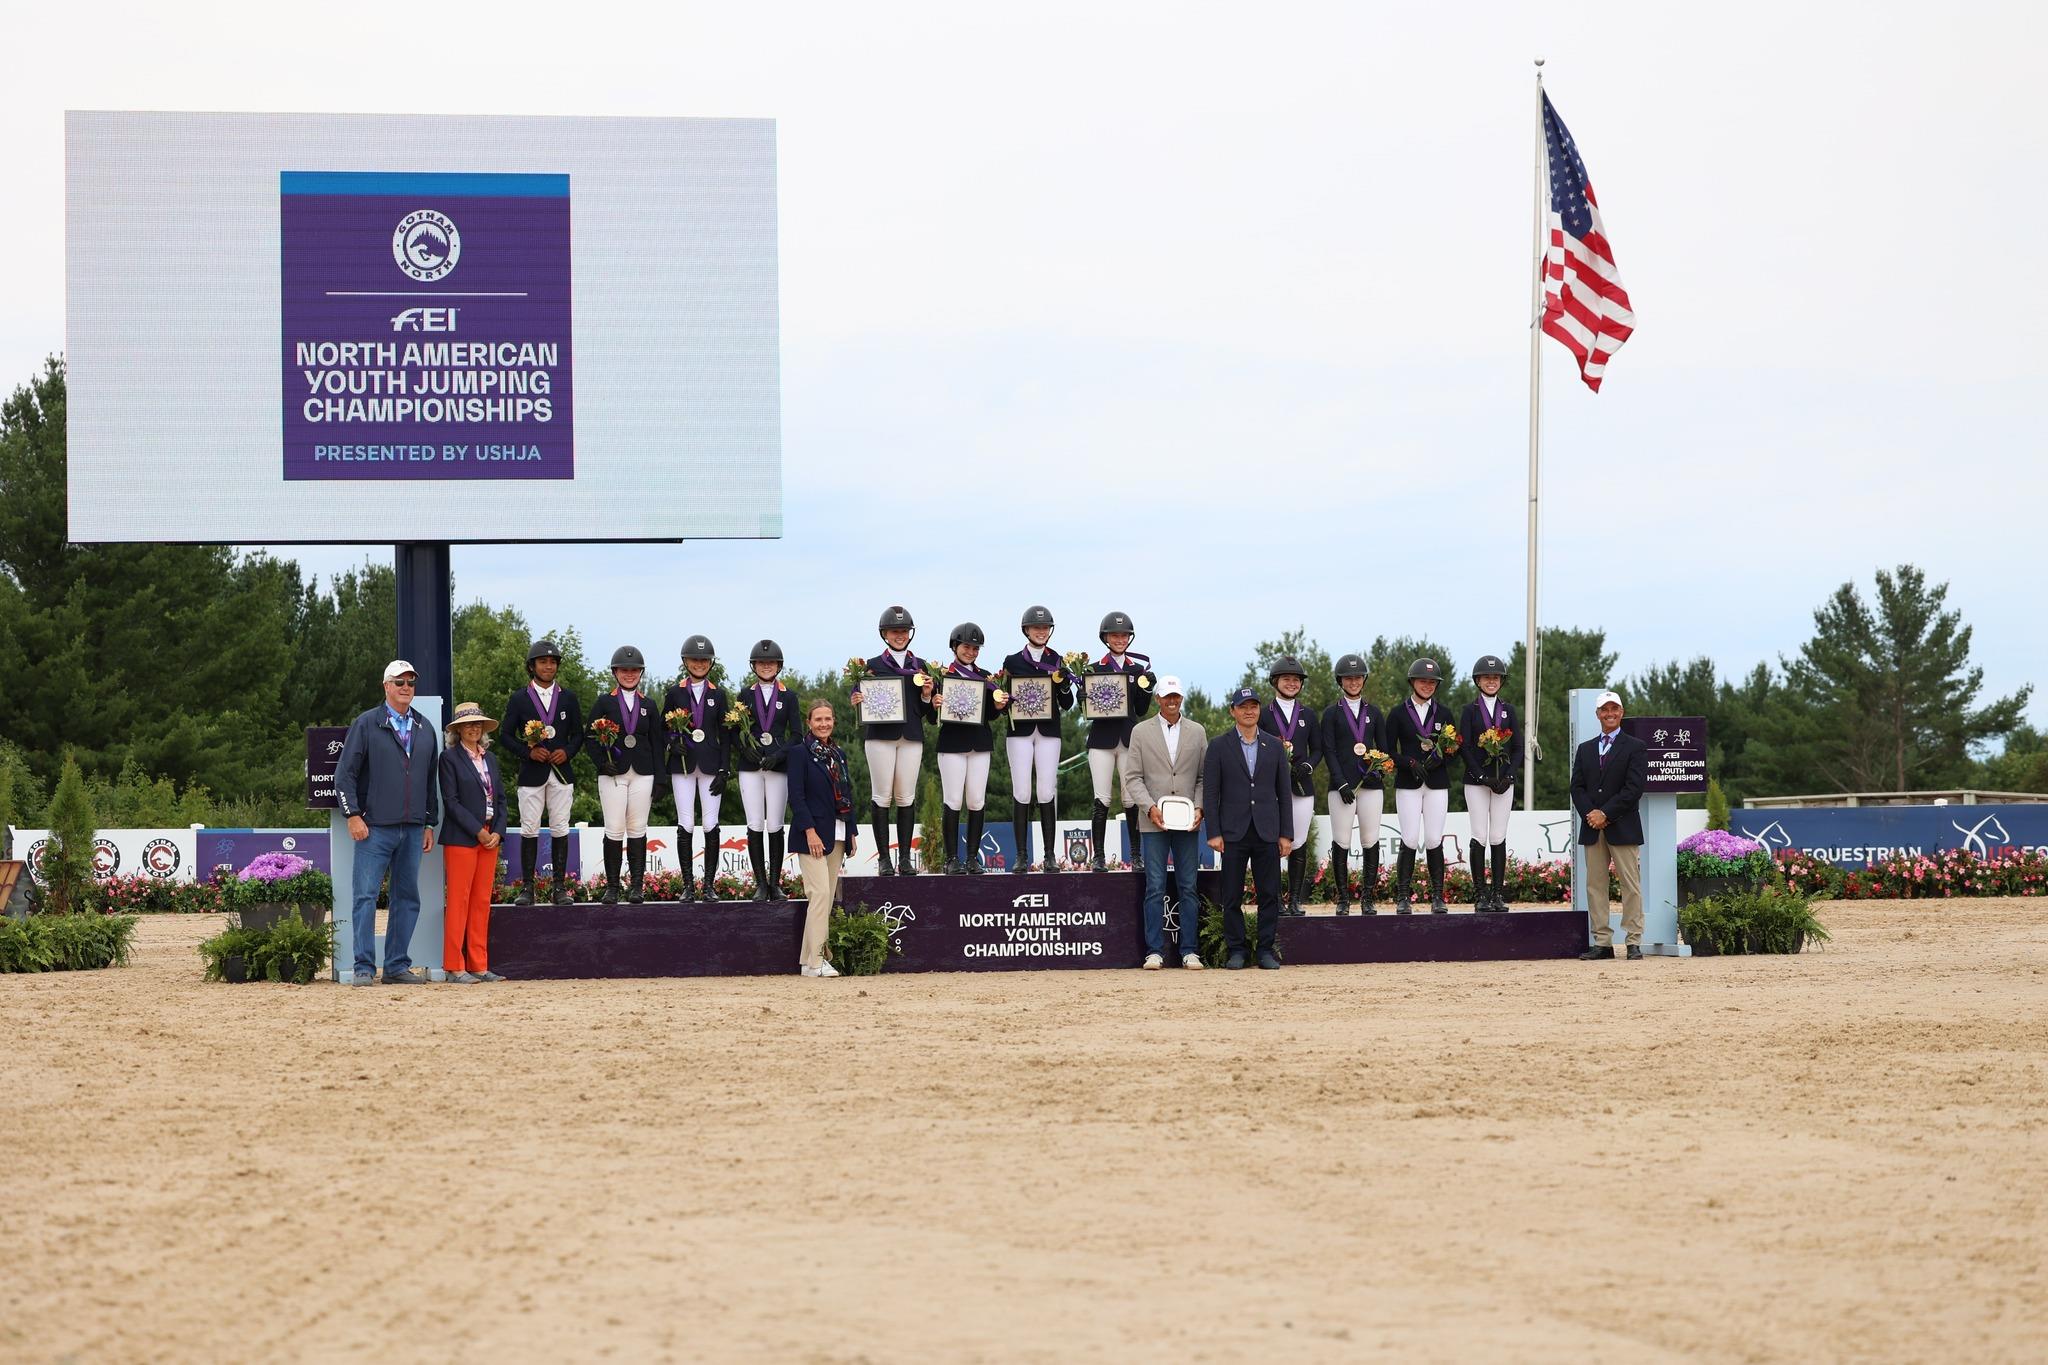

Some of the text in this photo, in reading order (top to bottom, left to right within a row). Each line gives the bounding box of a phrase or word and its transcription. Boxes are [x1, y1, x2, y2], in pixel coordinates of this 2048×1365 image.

[398, 211, 456, 235] GOTHAM
[399, 259, 453, 280] NORTH
[390, 307, 457, 332] FEI
[296, 342, 558, 367] NORTH AMERICAN
[304, 370, 551, 395] YOUTH JUMPING
[303, 397, 553, 422] CHAMPIONSHIPS
[314, 445, 542, 461] PRESENTED BY USHJA
[1666, 760, 1705, 768] AMERICAN
[311, 774, 335, 782] NORT
[1647, 774, 1704, 782] HAMPIONSHIPS
[340, 791, 351, 815] ARIAT
[145, 839, 177, 853] GOTHAM
[146, 865, 177, 878] NORTH
[1012, 893, 1049, 908] FEI
[959, 911, 1106, 928] NORTH AMERICAN
[1004, 927, 1061, 941] YOUTH
[963, 942, 1103, 957] CHAMPIONSHIPS
